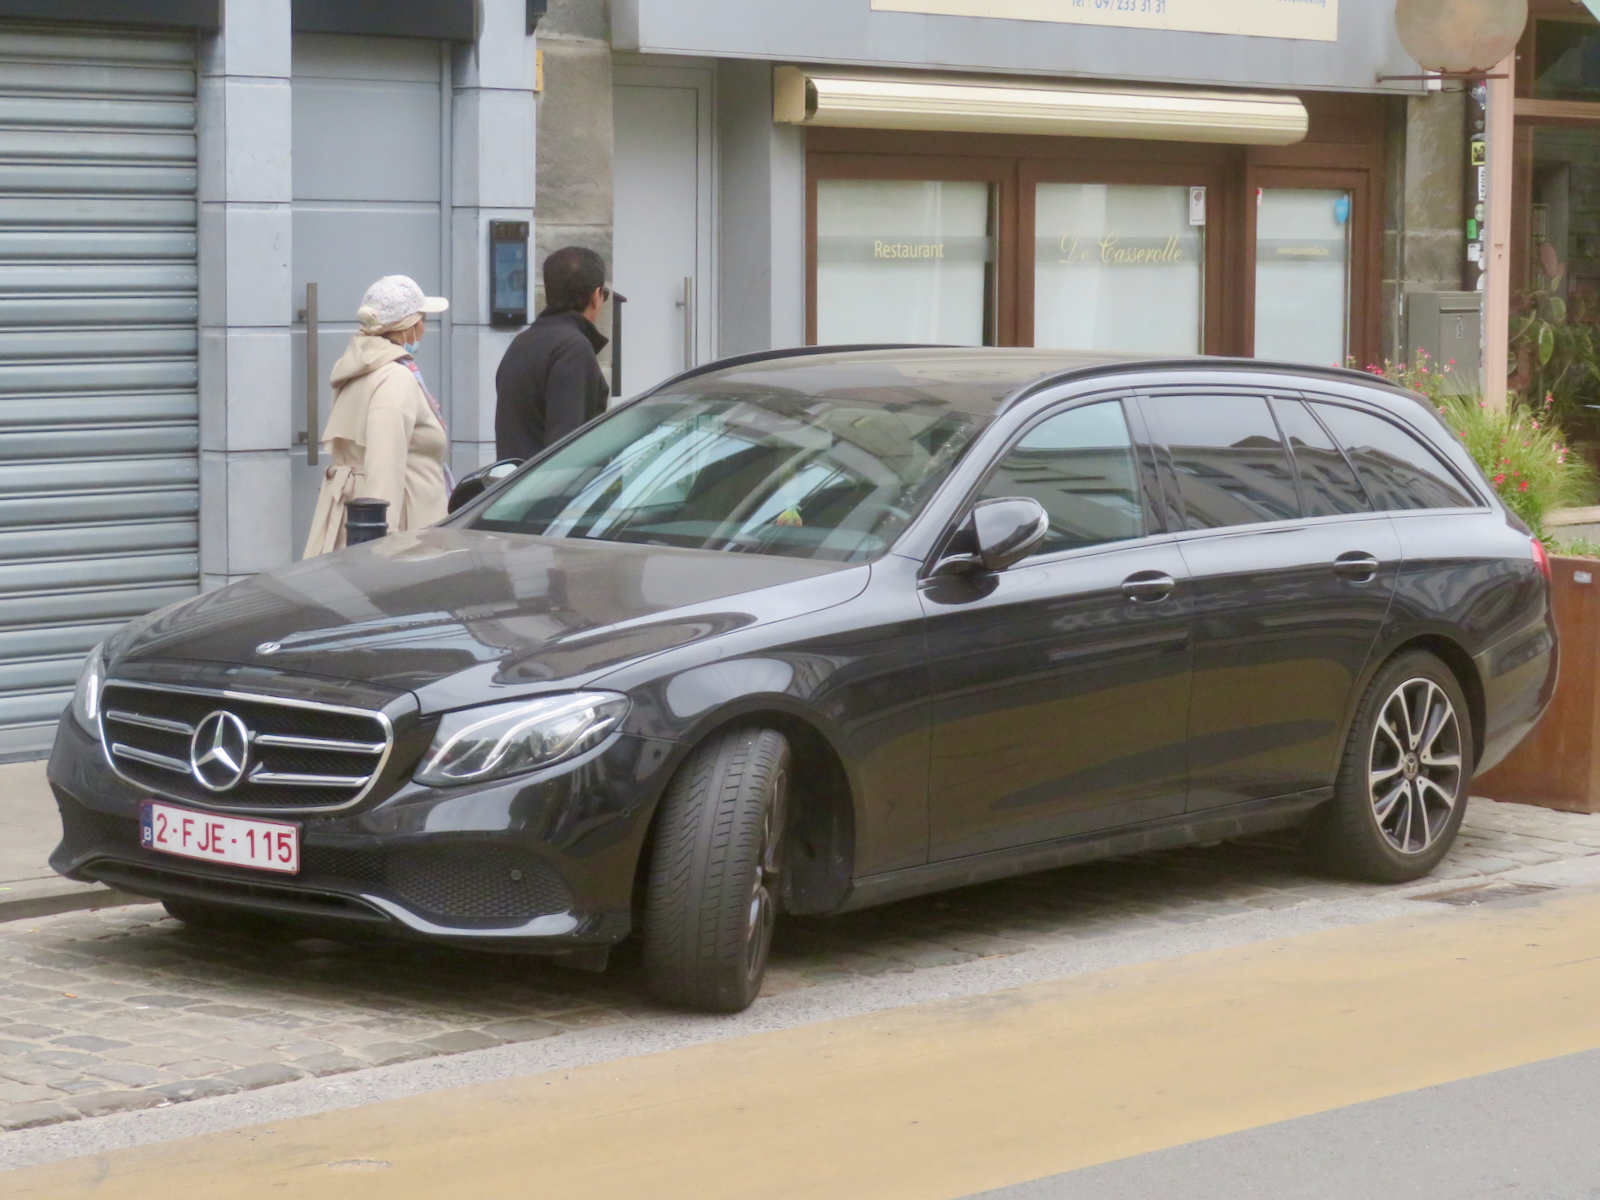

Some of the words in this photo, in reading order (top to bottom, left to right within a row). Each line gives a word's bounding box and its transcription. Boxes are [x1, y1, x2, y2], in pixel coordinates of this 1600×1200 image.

[1155, 0, 1165, 13] 31
[874, 240, 944, 258] Restaurant
[1099, 230, 1182, 263] Casserolle
[143, 827, 151, 841] B
